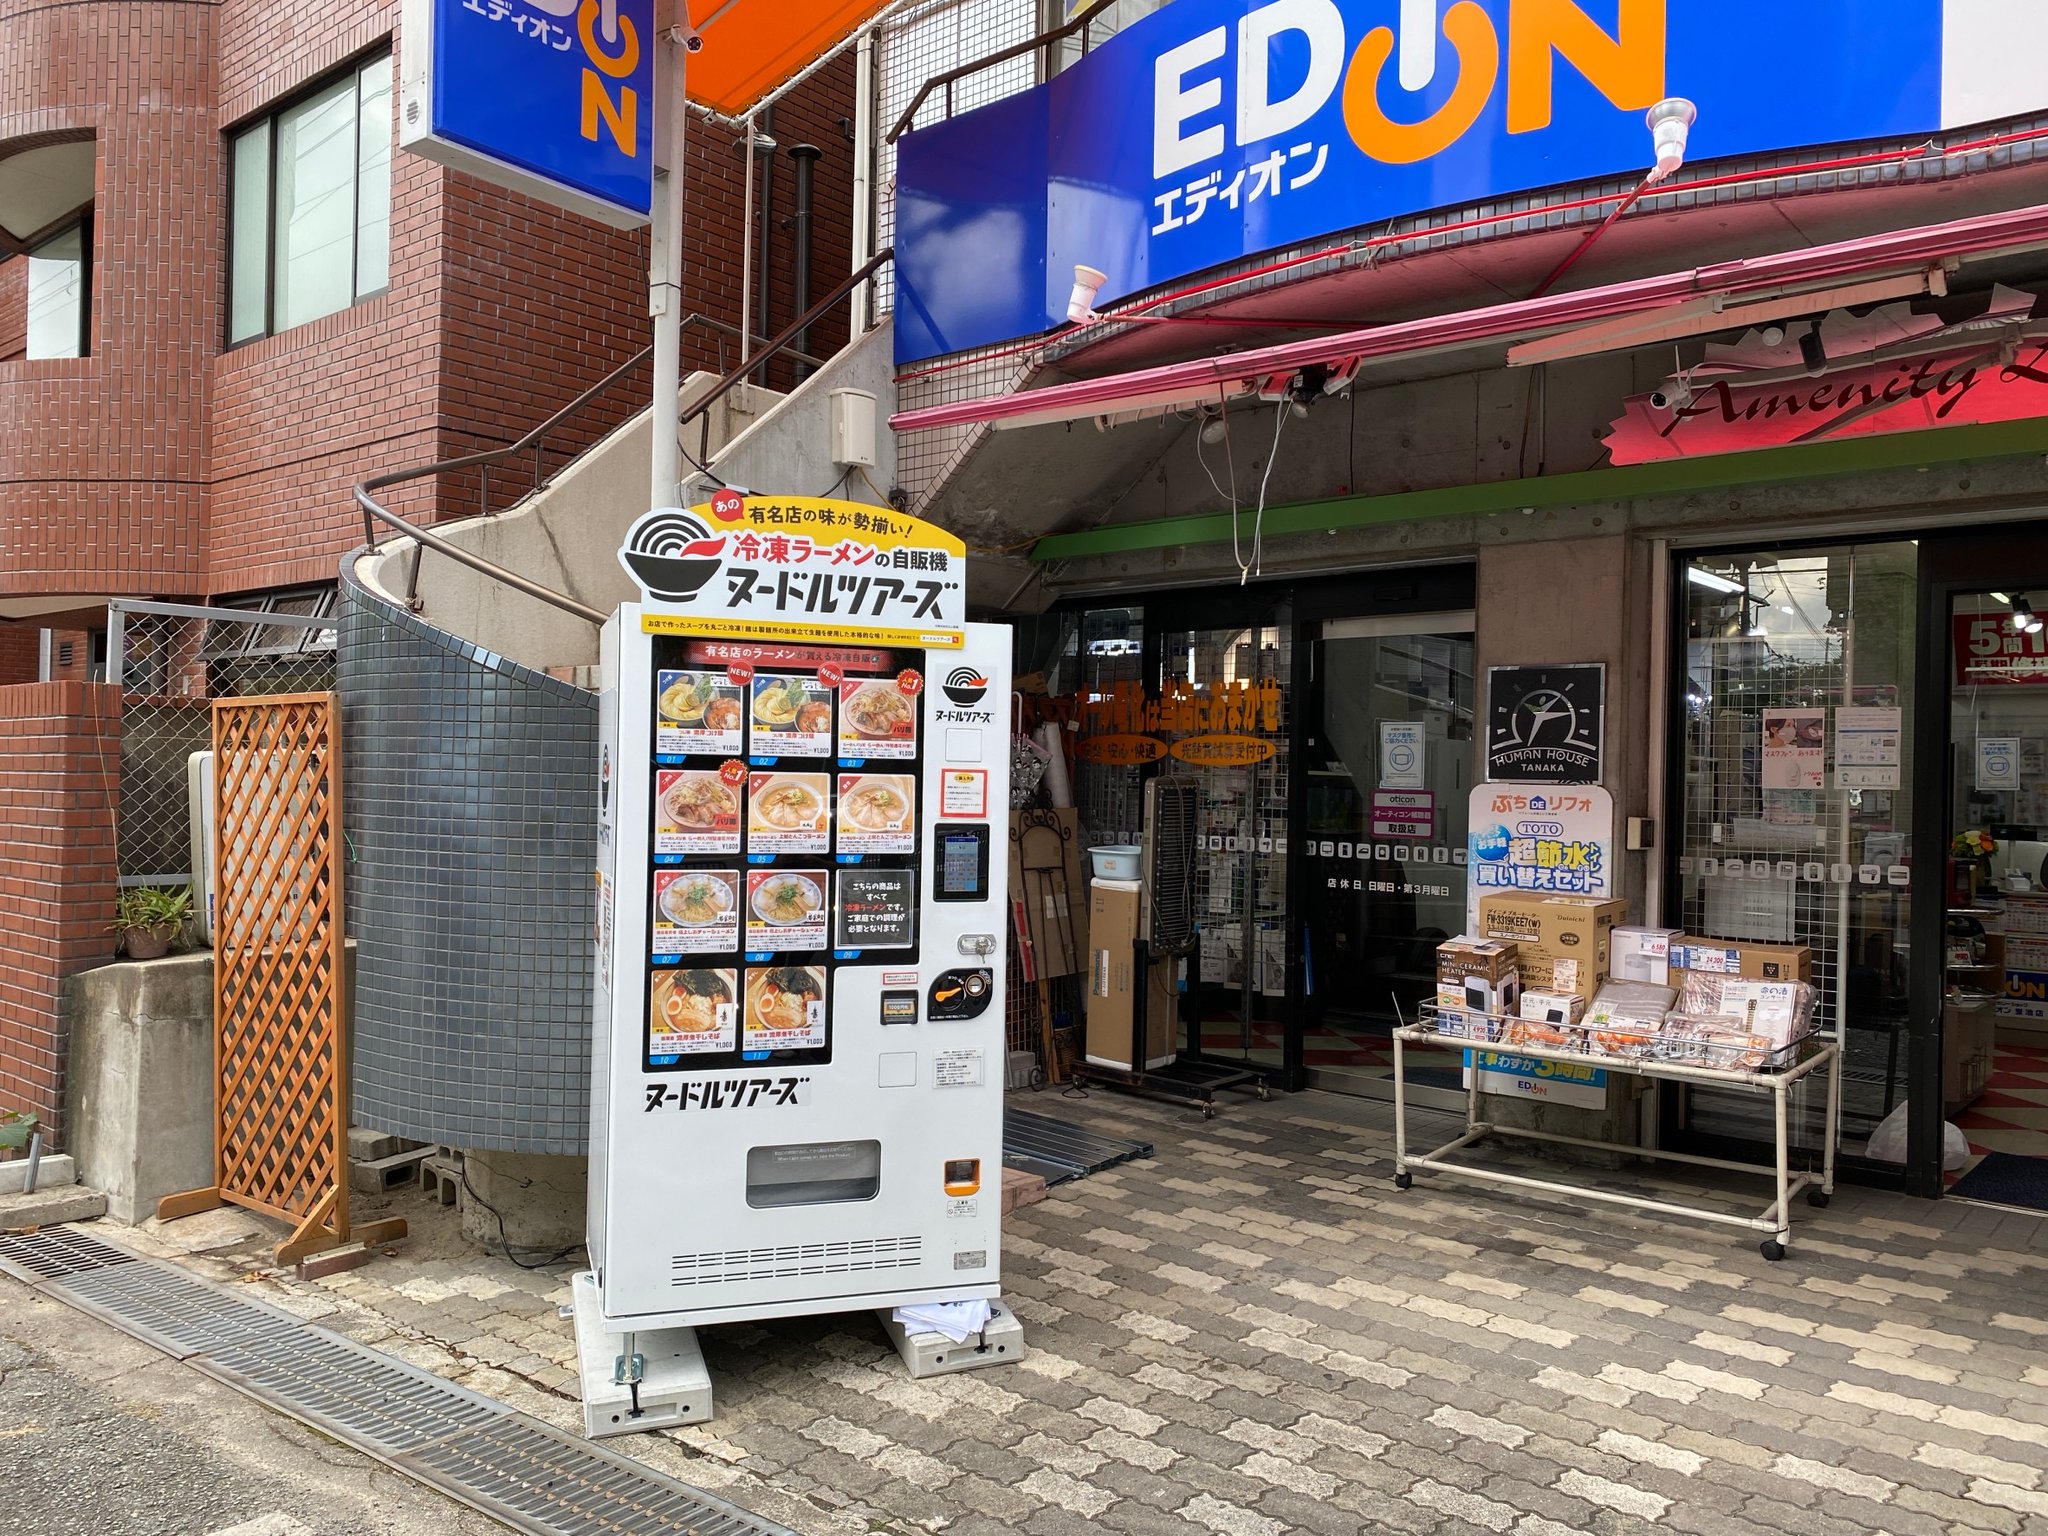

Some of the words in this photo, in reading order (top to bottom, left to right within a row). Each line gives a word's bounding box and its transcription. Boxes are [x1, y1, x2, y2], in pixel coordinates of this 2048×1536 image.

[1152, 142, 1329, 236] エディオン
[1660, 358, 1980, 438] Amenity
[715, 497, 740, 512] あの
[732, 533, 948, 573] 冷凍ラーメンの自販機
[725, 567, 959, 620] ヌードルツアーズ
[729, 667, 752, 679] NEW!
[820, 667, 841, 683] NEW!
[935, 710, 995, 724] ヌードルツアーズ
[758, 757, 768, 765] 02
[846, 759, 857, 767] 03
[1495, 748, 1542, 768] HUMAN
[1546, 749, 1590, 768] HOUSE
[1521, 763, 1565, 773] TANAKA
[1389, 795, 1416, 804] oticon
[1387, 823, 1417, 834] 取扱店
[1522, 824, 1559, 835] TOTO
[664, 855, 675, 863] 04
[1477, 864, 1603, 892] 買い替えセット
[852, 882, 902, 891] こちらの商品は
[865, 893, 888, 901] すべて
[847, 913, 906, 922] ご家庭での調理が
[847, 924, 901, 933] 必要となります。
[661, 955, 672, 963] 07
[1441, 967, 1466, 976] HEATER
[1459, 962, 1491, 973] CERAMIC
[1517, 1080, 1548, 1096] EDION
[644, 1077, 810, 1112] ヌードルツアーズ
